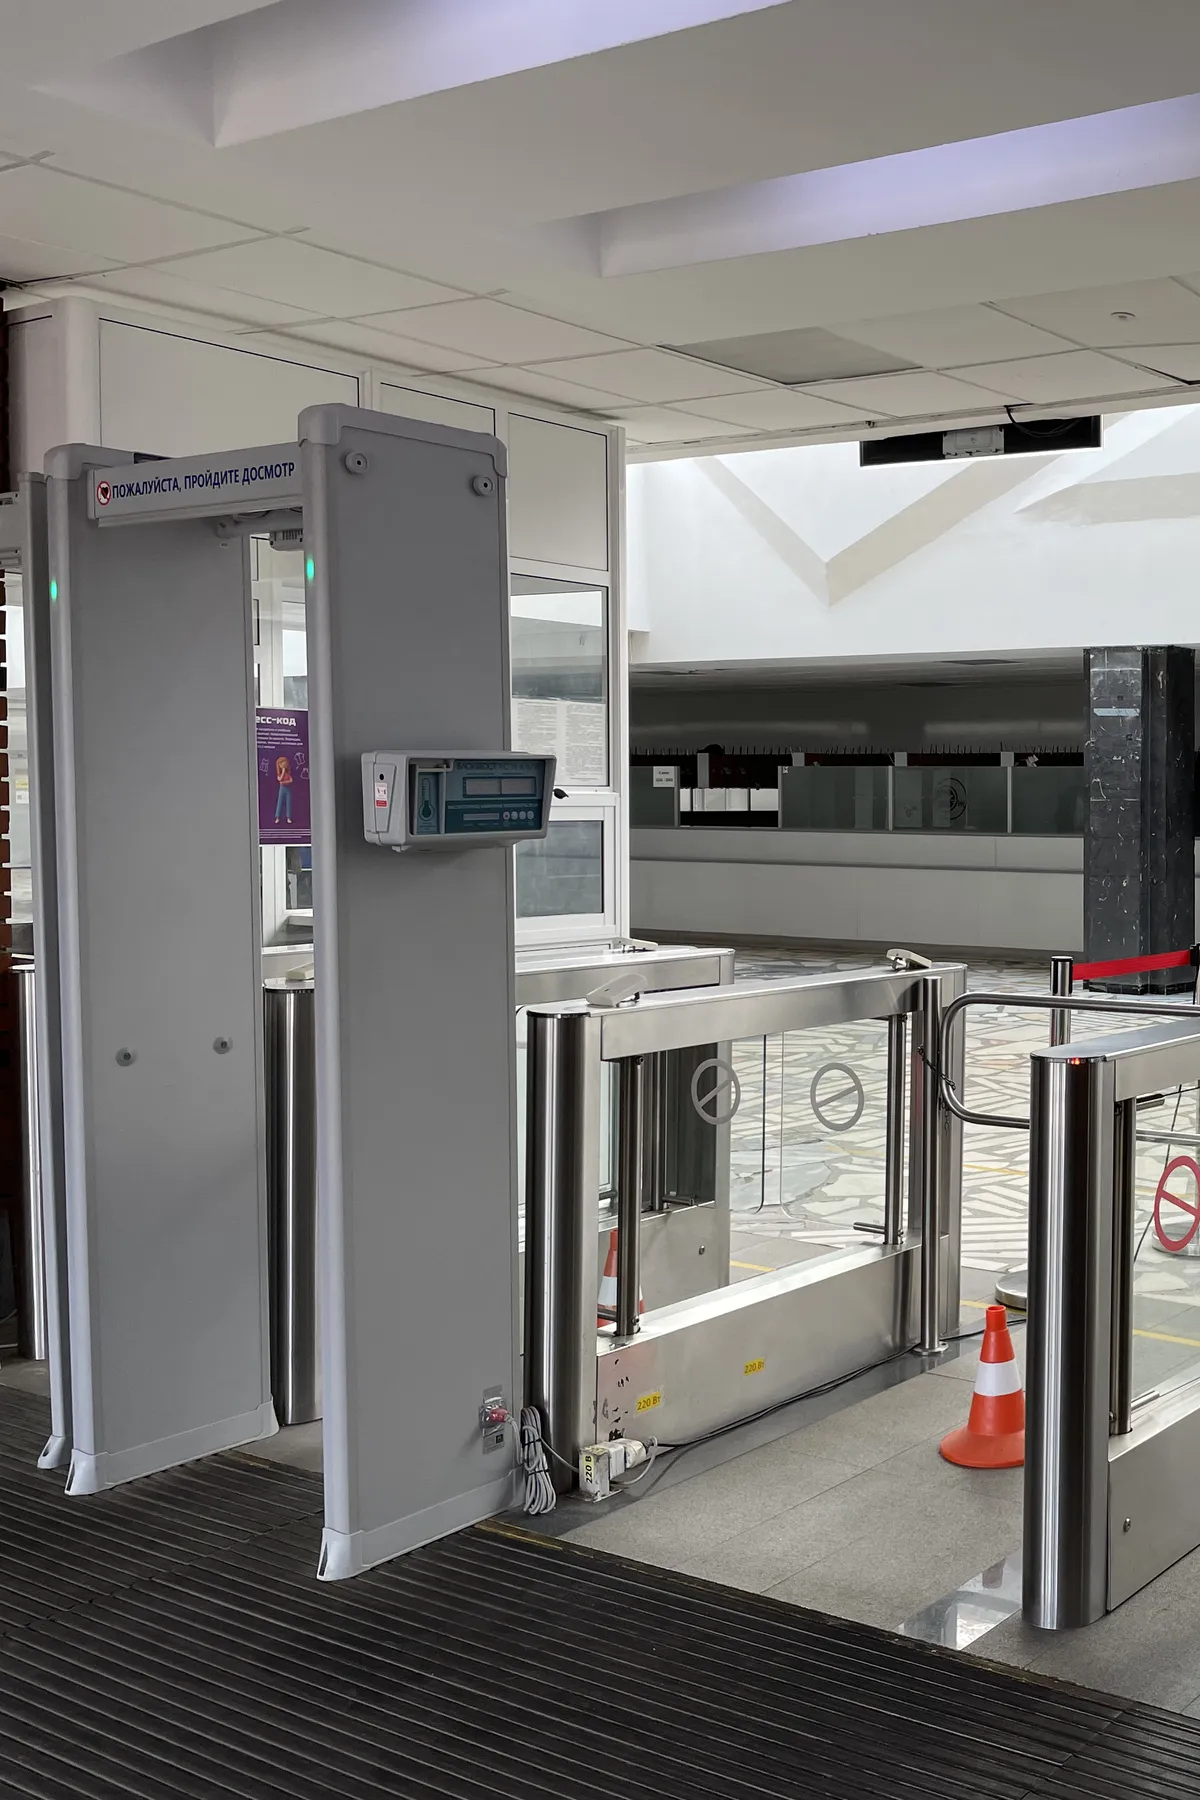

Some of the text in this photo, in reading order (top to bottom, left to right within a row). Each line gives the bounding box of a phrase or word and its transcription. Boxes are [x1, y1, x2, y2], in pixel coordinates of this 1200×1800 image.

[112, 462, 295, 499] ПОЖАЛУЙСТА, ПРОЙДИТЕ ДОСМОТР
[637, 1398, 651, 1411] 220
[585, 1465, 593, 1484] 220
